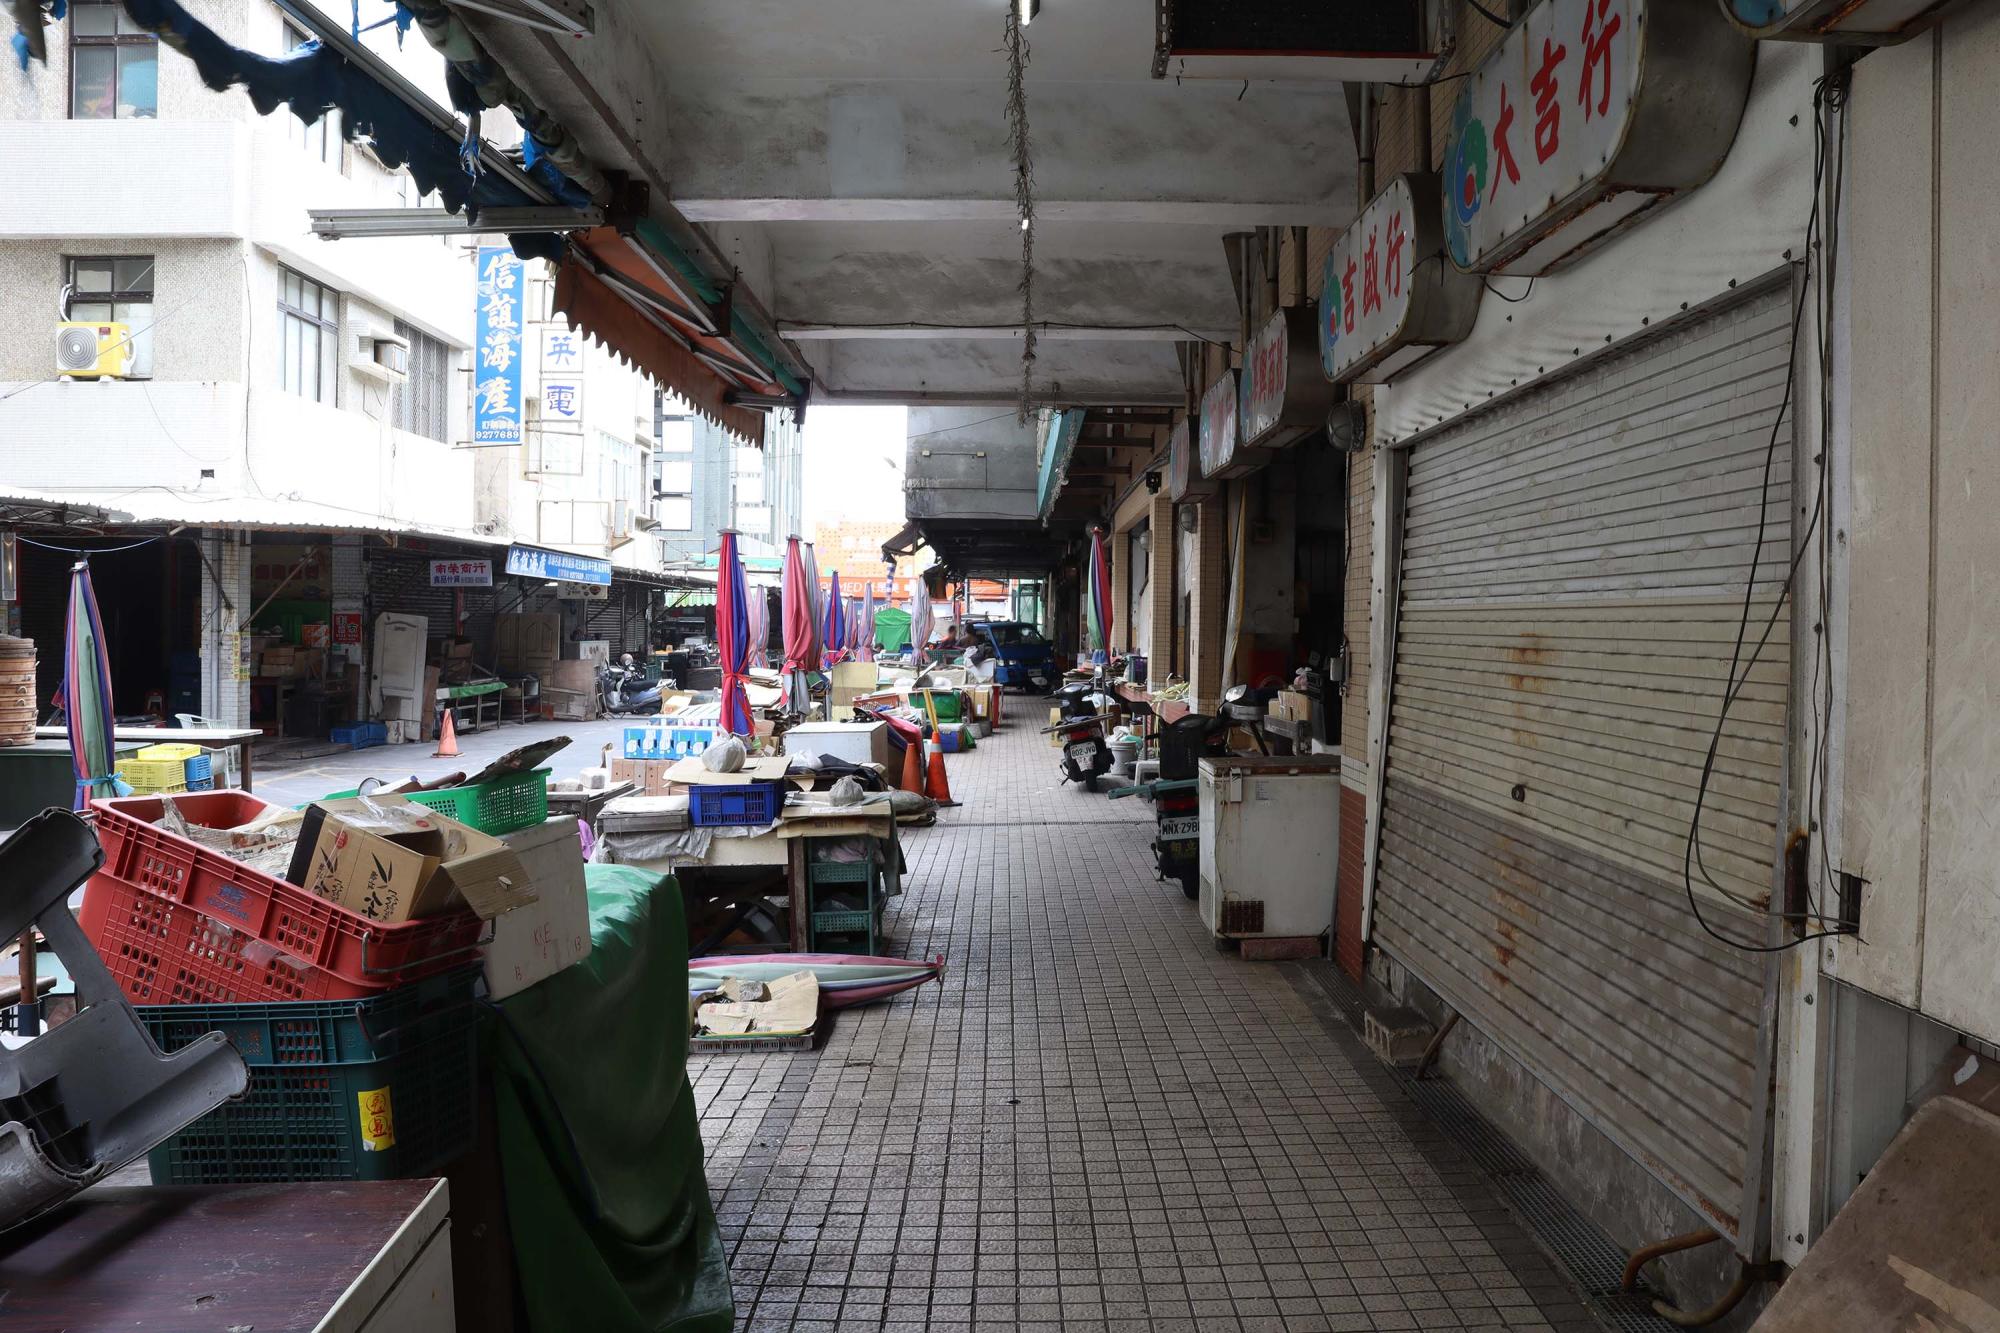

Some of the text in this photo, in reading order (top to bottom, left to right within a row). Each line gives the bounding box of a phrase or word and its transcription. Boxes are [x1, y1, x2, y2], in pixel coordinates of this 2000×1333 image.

[1490, 0, 1621, 205] 大吉行
[480, 254, 519, 415] 信誼海產
[475, 430, 519, 439] 9277689
[1162, 818, 1200, 835] MNX-298
